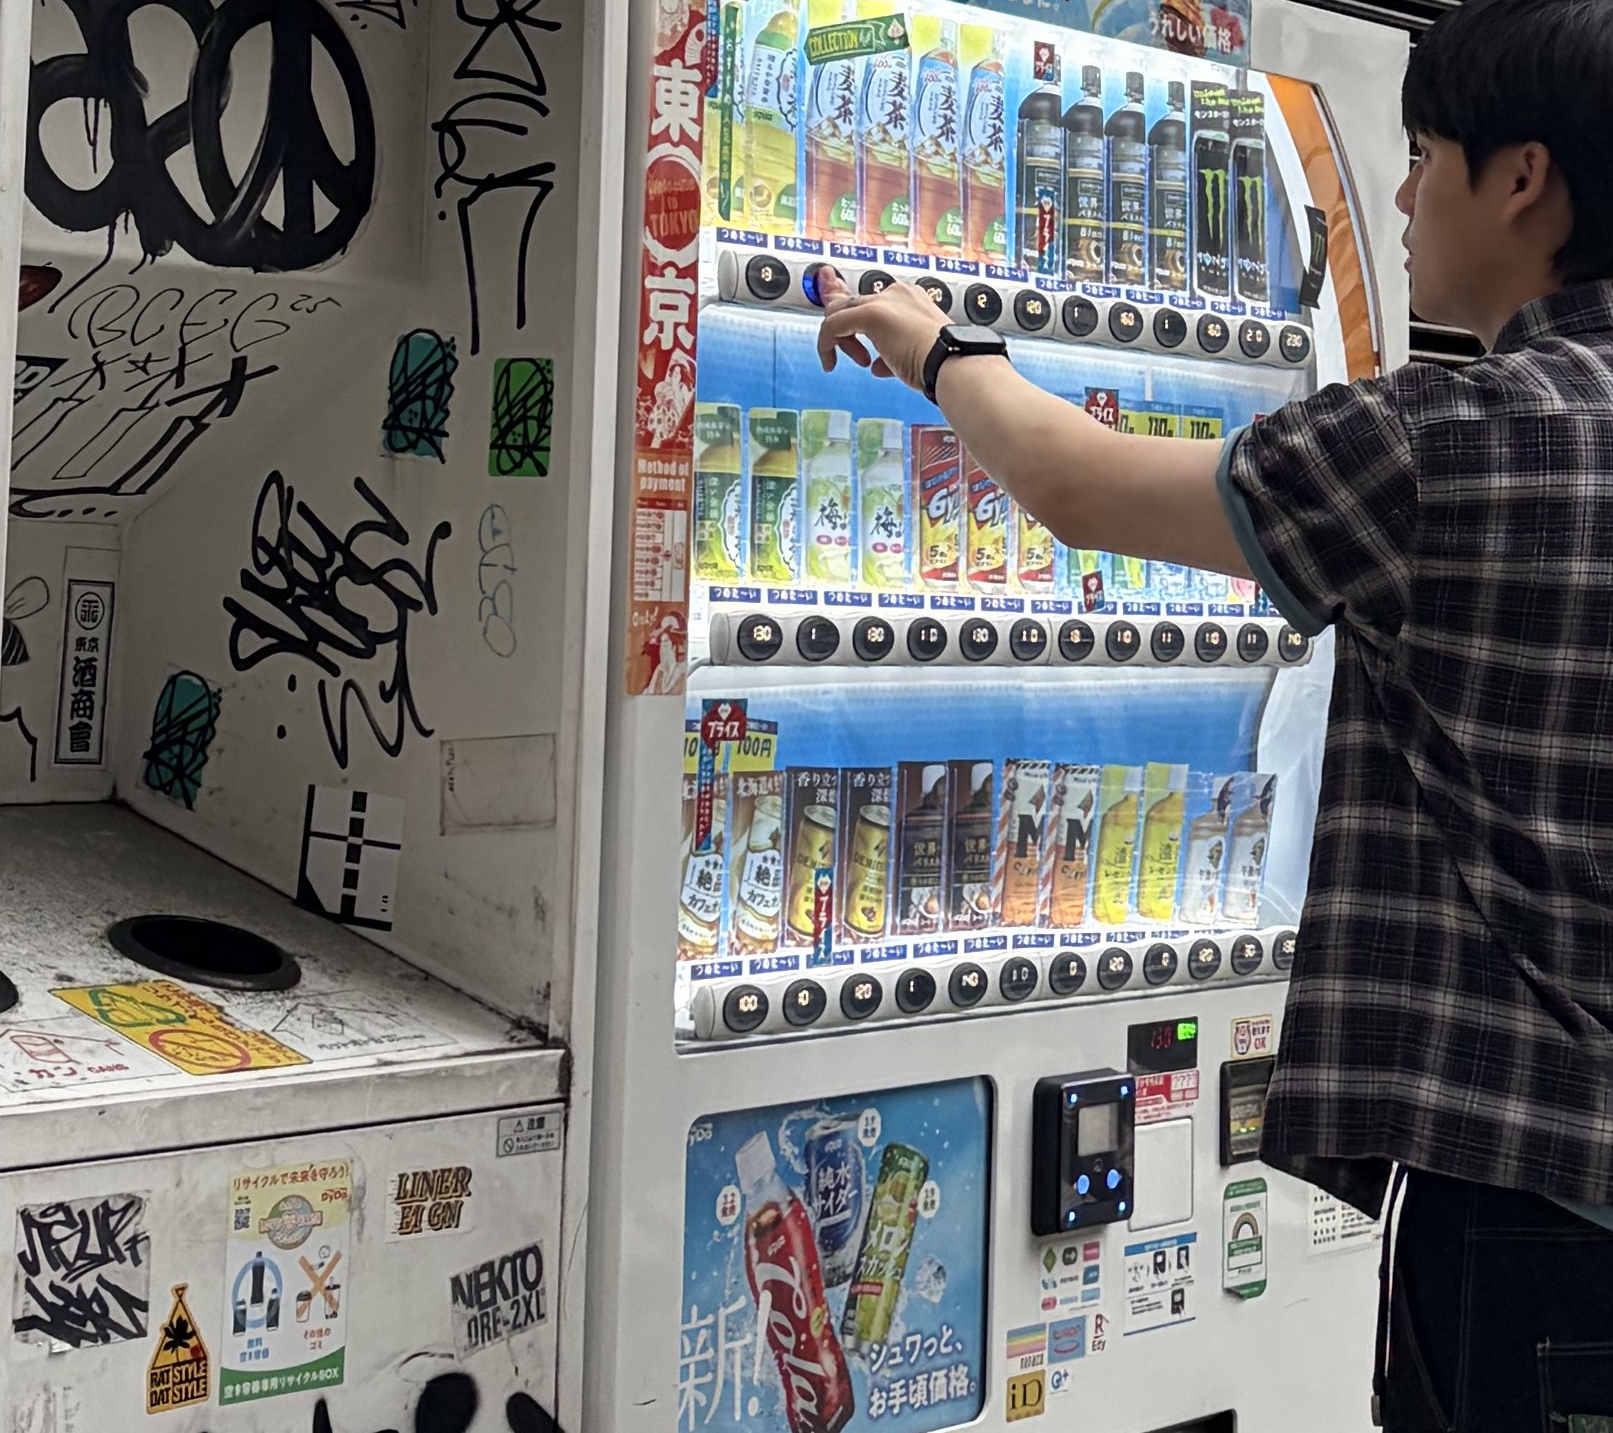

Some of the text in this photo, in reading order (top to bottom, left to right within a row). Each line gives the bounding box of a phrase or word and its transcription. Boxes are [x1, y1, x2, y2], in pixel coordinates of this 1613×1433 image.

[637, 458, 675, 475] Method
[639, 478, 686, 494] payment
[736, 735, 772, 758] 100円
[394, 1165, 473, 1205] LINER
[818, 1165, 852, 1192] 純水
[868, 1364, 977, 1419] お手頃価格。
[1010, 1378, 1043, 1411] iD
